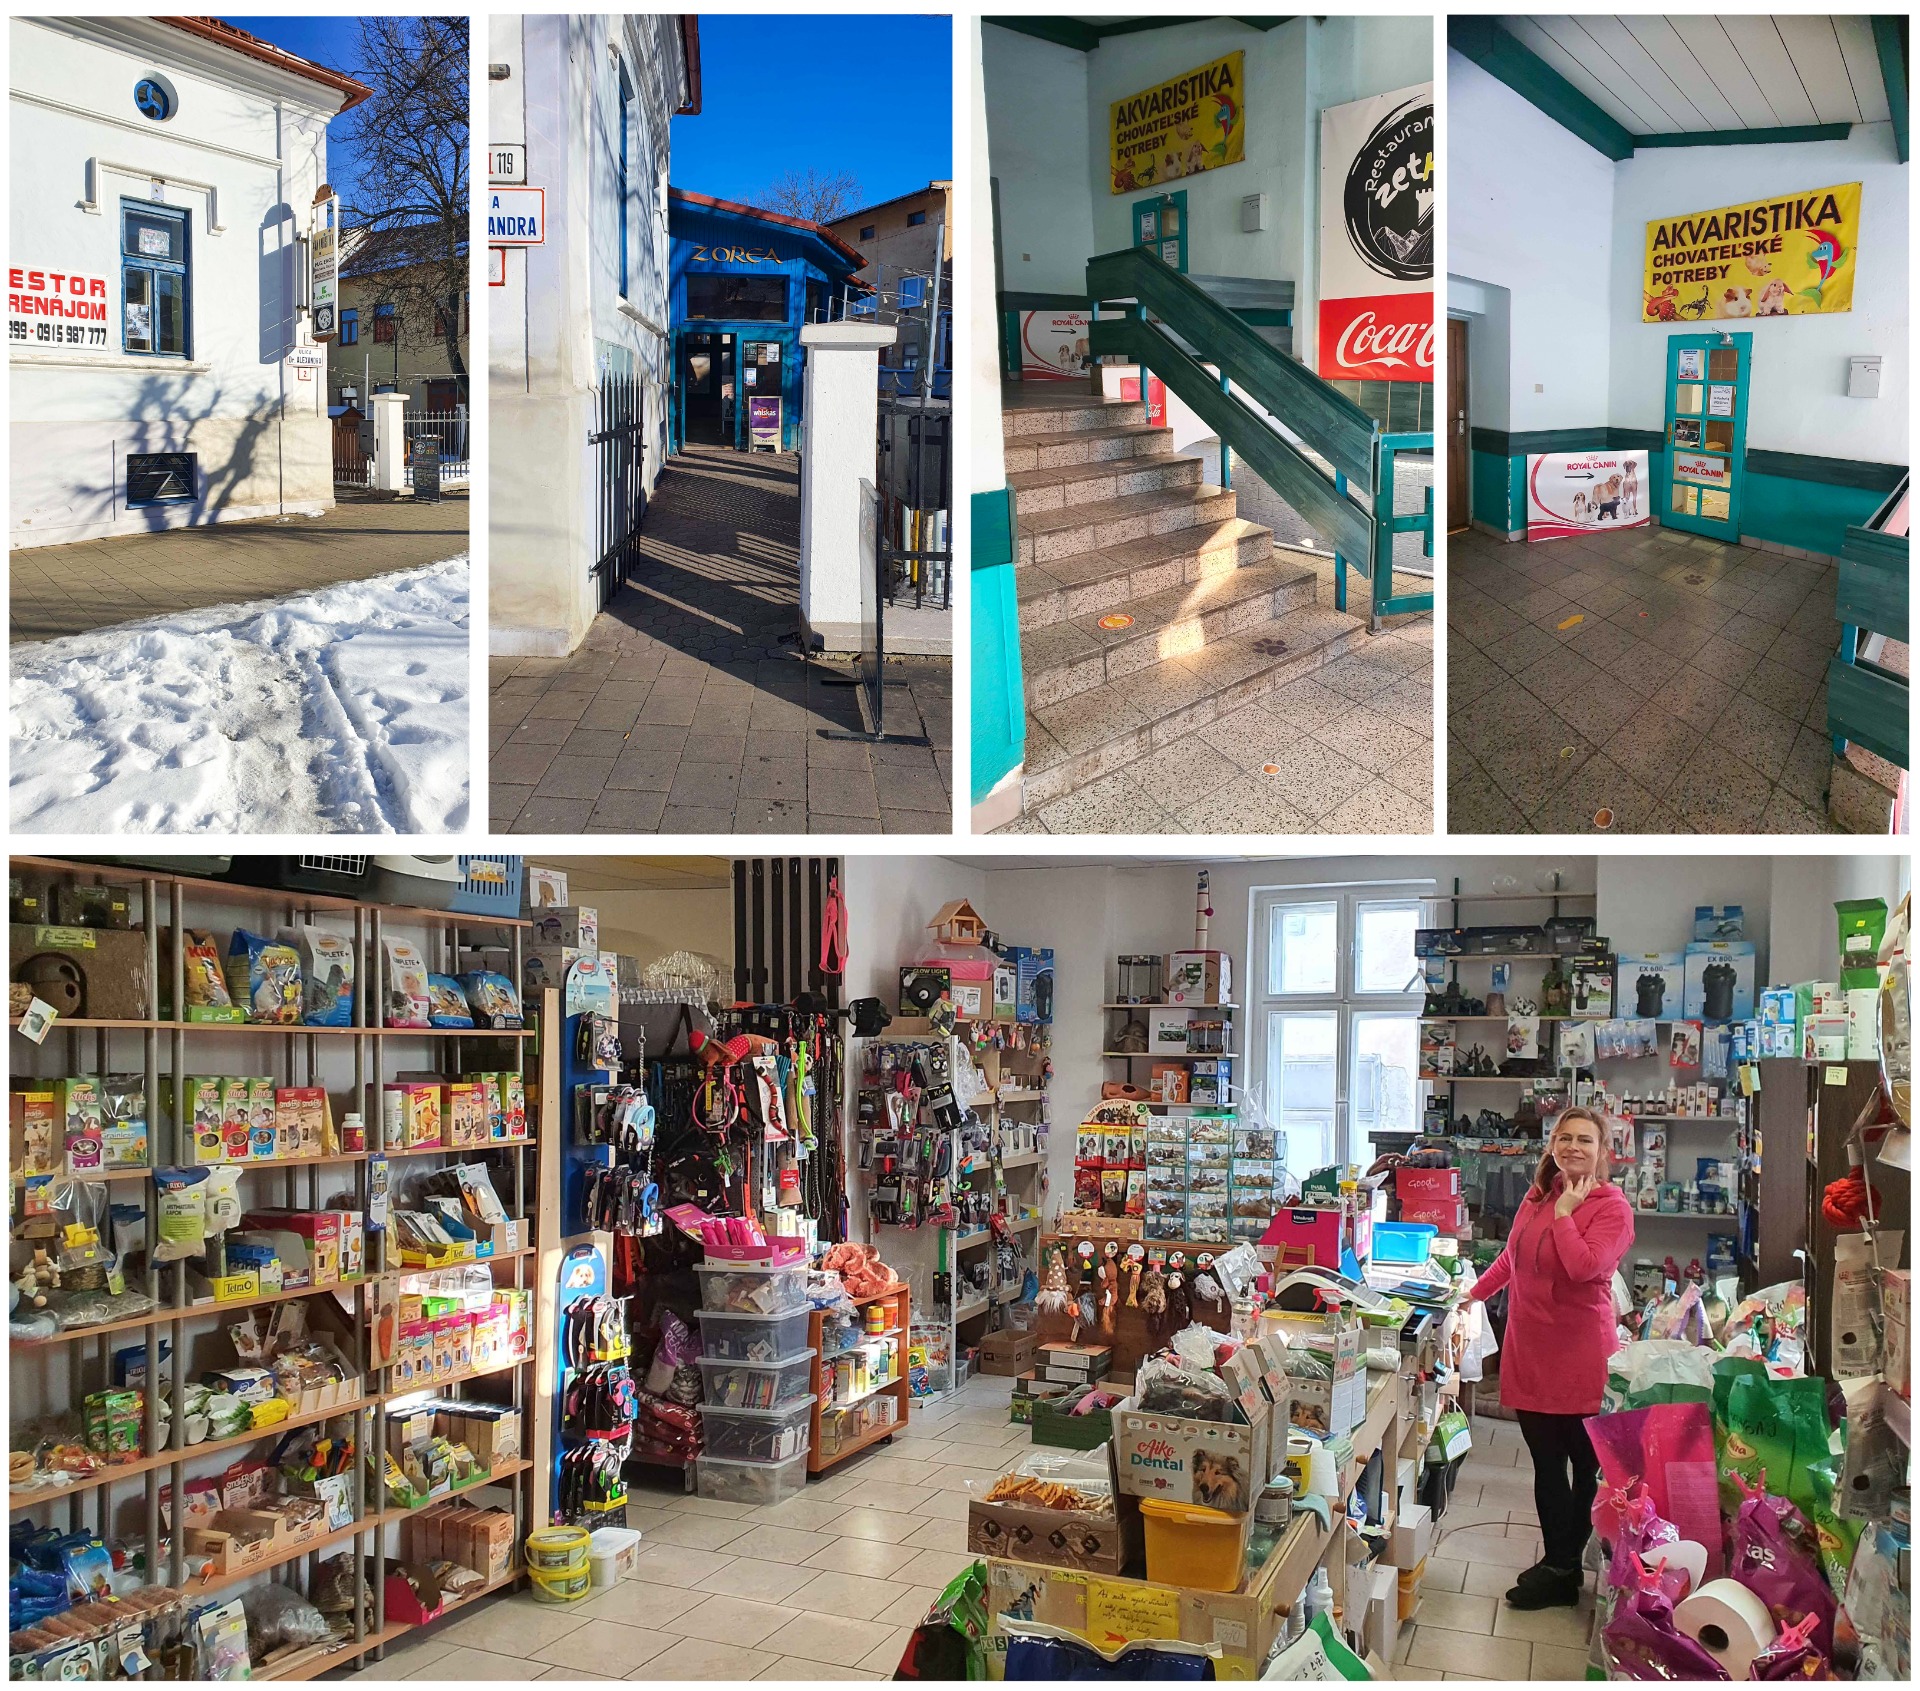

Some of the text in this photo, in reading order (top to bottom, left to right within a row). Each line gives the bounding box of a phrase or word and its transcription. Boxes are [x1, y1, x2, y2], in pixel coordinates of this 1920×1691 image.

[1116, 63, 1234, 130] AKVARISTIKA
[1117, 102, 1200, 145] CHOVATEĽSKÉ
[1117, 132, 1169, 161] POTREBY
[497, 152, 513, 174] 119
[492, 195, 500, 209] A
[488, 216, 537, 237] ANDRA
[1652, 193, 1842, 251] AKVARISTIKA
[1652, 234, 1783, 268] CHOVATEĽSKÉ
[9, 268, 105, 298] ESTOR
[1652, 263, 1731, 286] POTREBY
[9, 294, 106, 320] RENÁJOM
[37, 323, 63, 343] 0915
[66, 325, 85, 344] 987
[88, 327, 107, 346] 777
[1336, 311, 1434, 369] Coca-C
[753, 409, 777, 417] whiskas
[1567, 461, 1617, 471] ROYAL CANIN
[1679, 465, 1724, 478] ROYAL CANIN
[71, 1092, 96, 1101] Sticks
[198, 1089, 218, 1098] Sticks
[227, 1089, 247, 1098] Sticks
[253, 1088, 272, 1097] Sticks
[883, 1176, 895, 1184] KAY
[226, 1283, 244, 1293] Tetra
[1137, 1439, 1176, 1460] Aiko
[1130, 1453, 1183, 1471] Dental
[982, 1637, 1005, 1649] XS S
